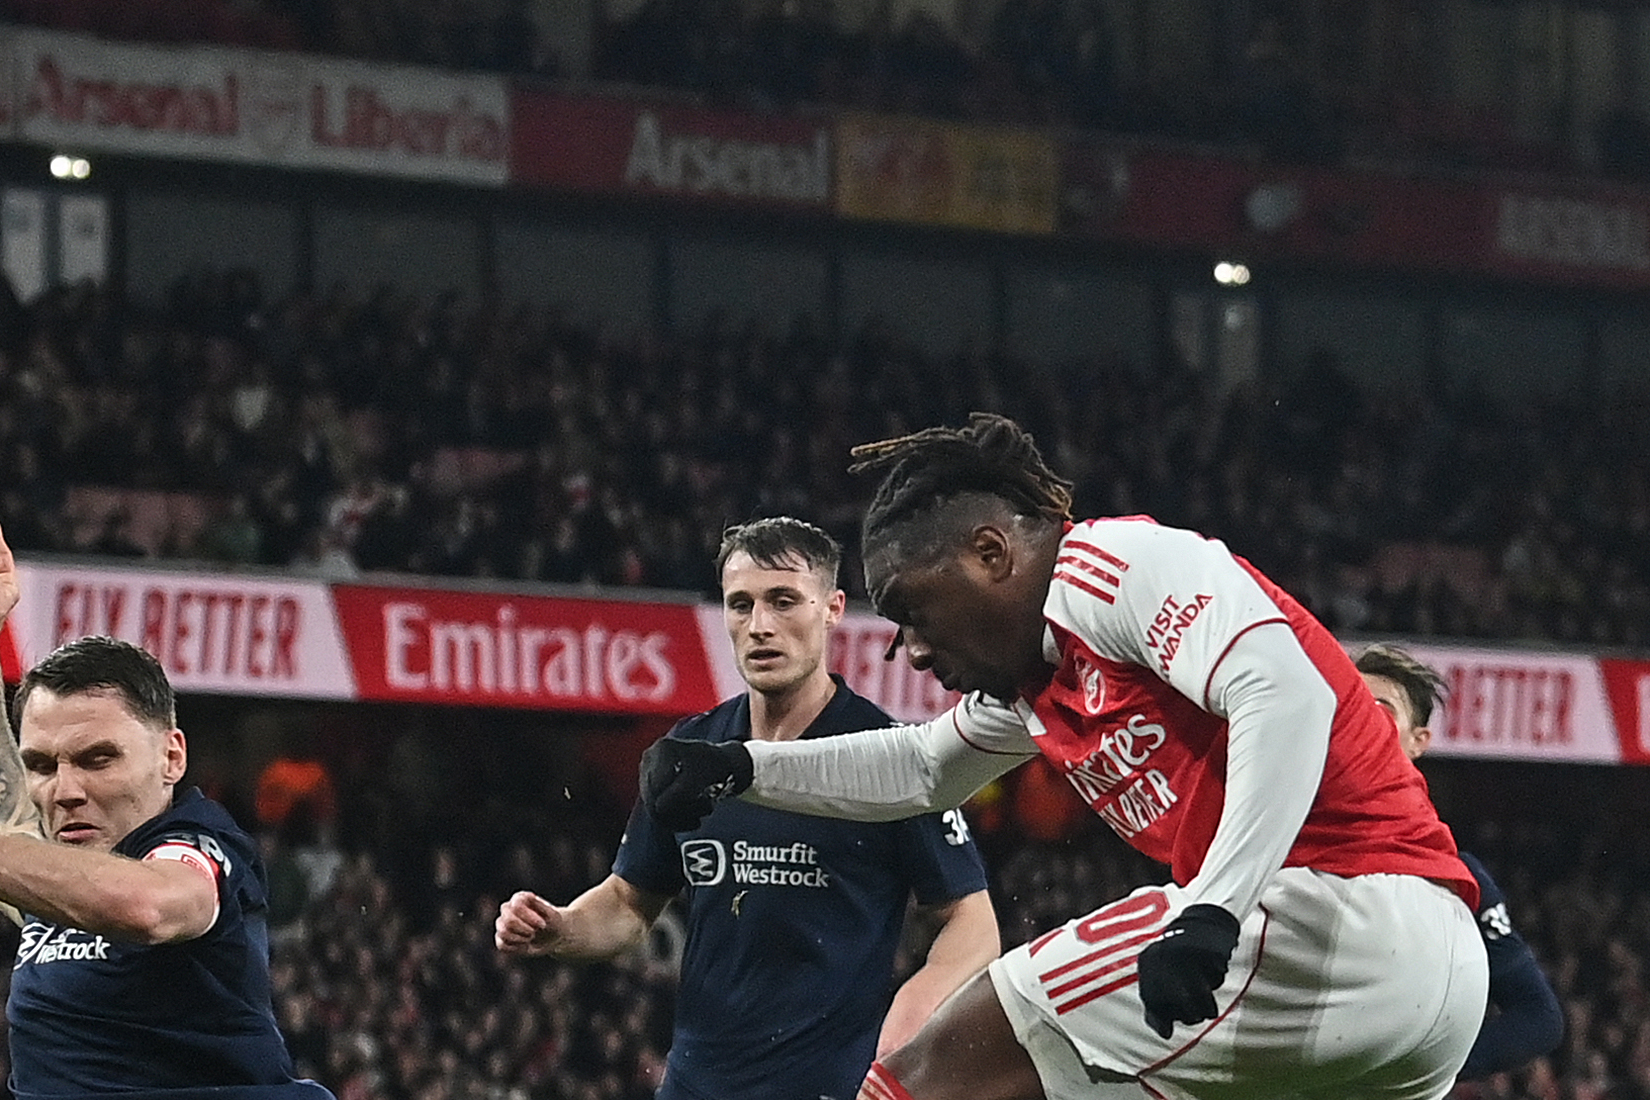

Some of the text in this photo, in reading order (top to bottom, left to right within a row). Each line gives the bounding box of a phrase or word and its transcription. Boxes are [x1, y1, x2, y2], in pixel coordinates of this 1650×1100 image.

[26, 55, 240, 140] Arsenal
[622, 110, 832, 202] Arsenal
[140, 584, 304, 679] BETTER
[381, 601, 679, 703] Emirates
[1145, 594, 1180, 649] VISIT
[732, 840, 818, 867] Smurfit
[732, 863, 829, 889] Westrock
